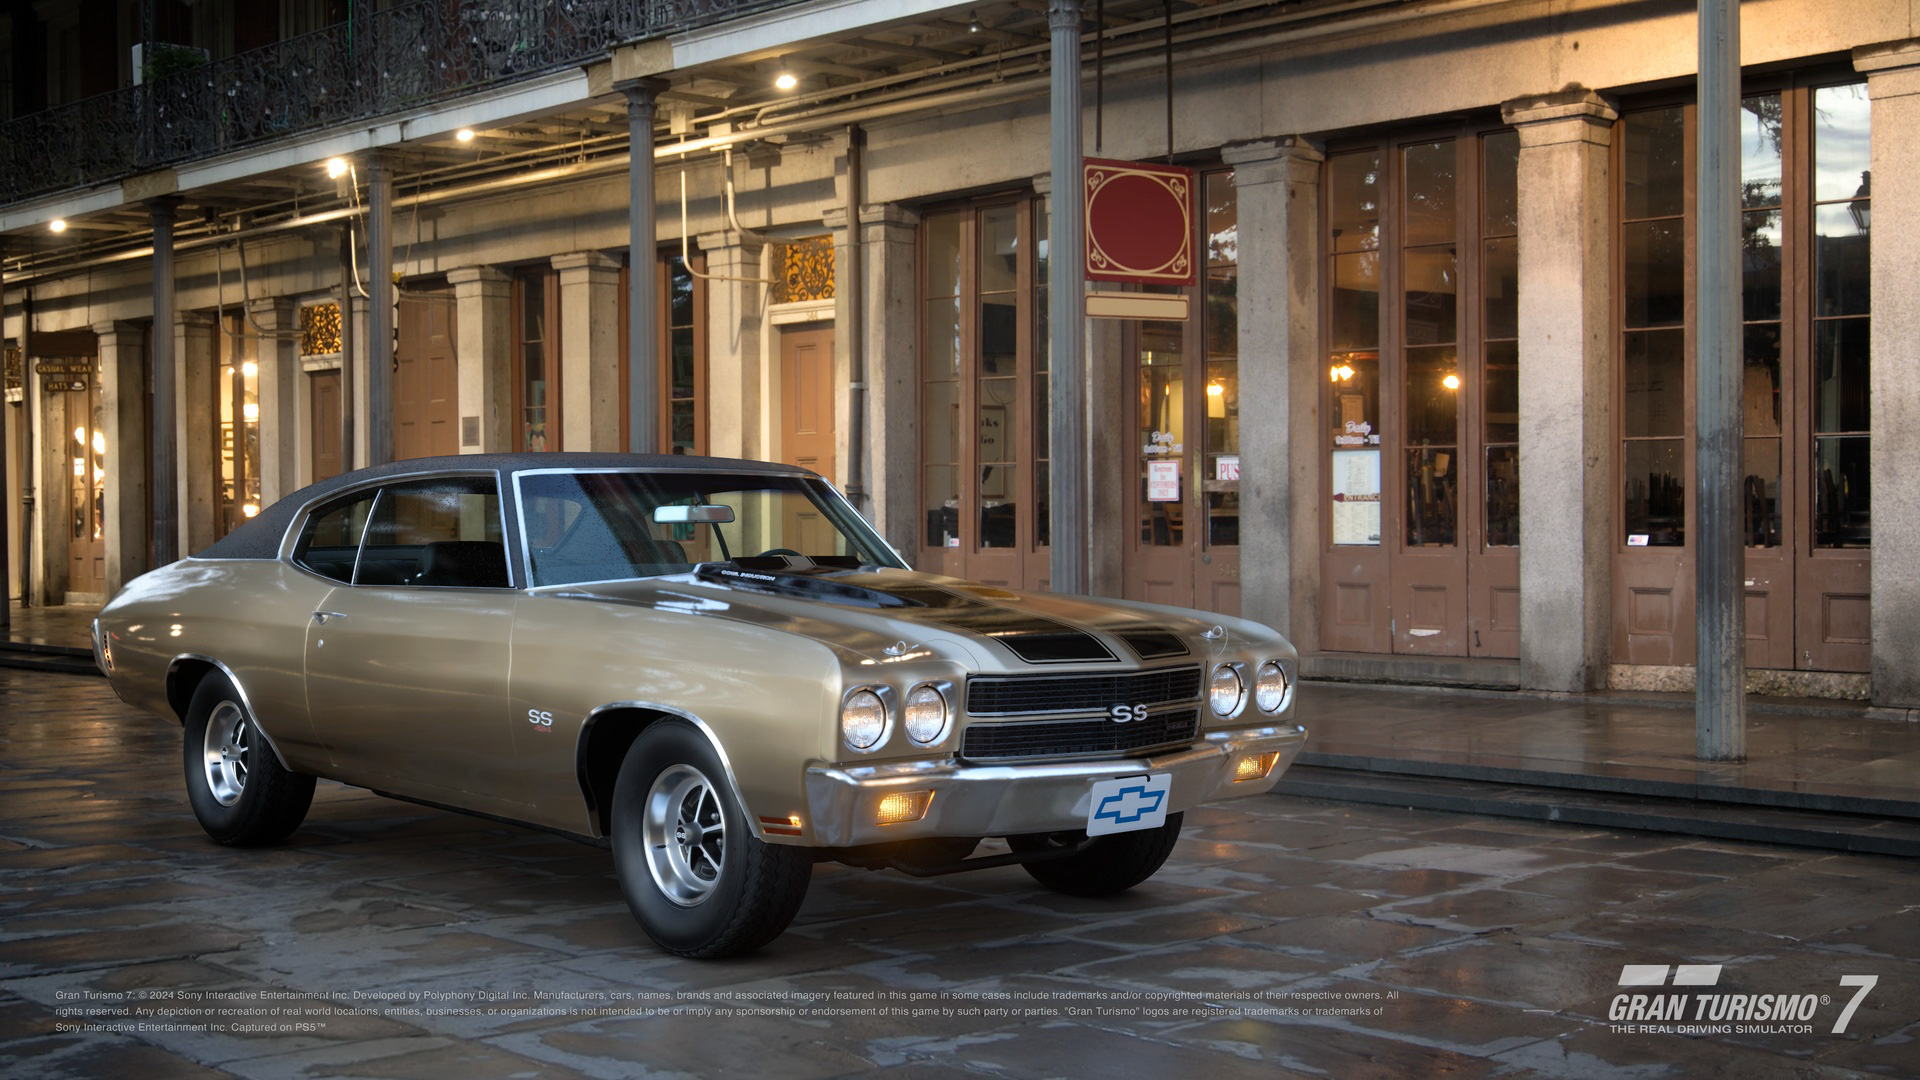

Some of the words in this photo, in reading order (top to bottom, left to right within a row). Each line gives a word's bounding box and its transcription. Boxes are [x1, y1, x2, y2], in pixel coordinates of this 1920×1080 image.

[38, 365, 65, 373] CASUAL
[70, 364, 93, 373] WEAR
[47, 382, 68, 391] HATS
[1219, 463, 1240, 480] PUS
[1344, 493, 1380, 502] ENTRANC
[528, 708, 553, 727] SS
[1111, 703, 1149, 724] SS
